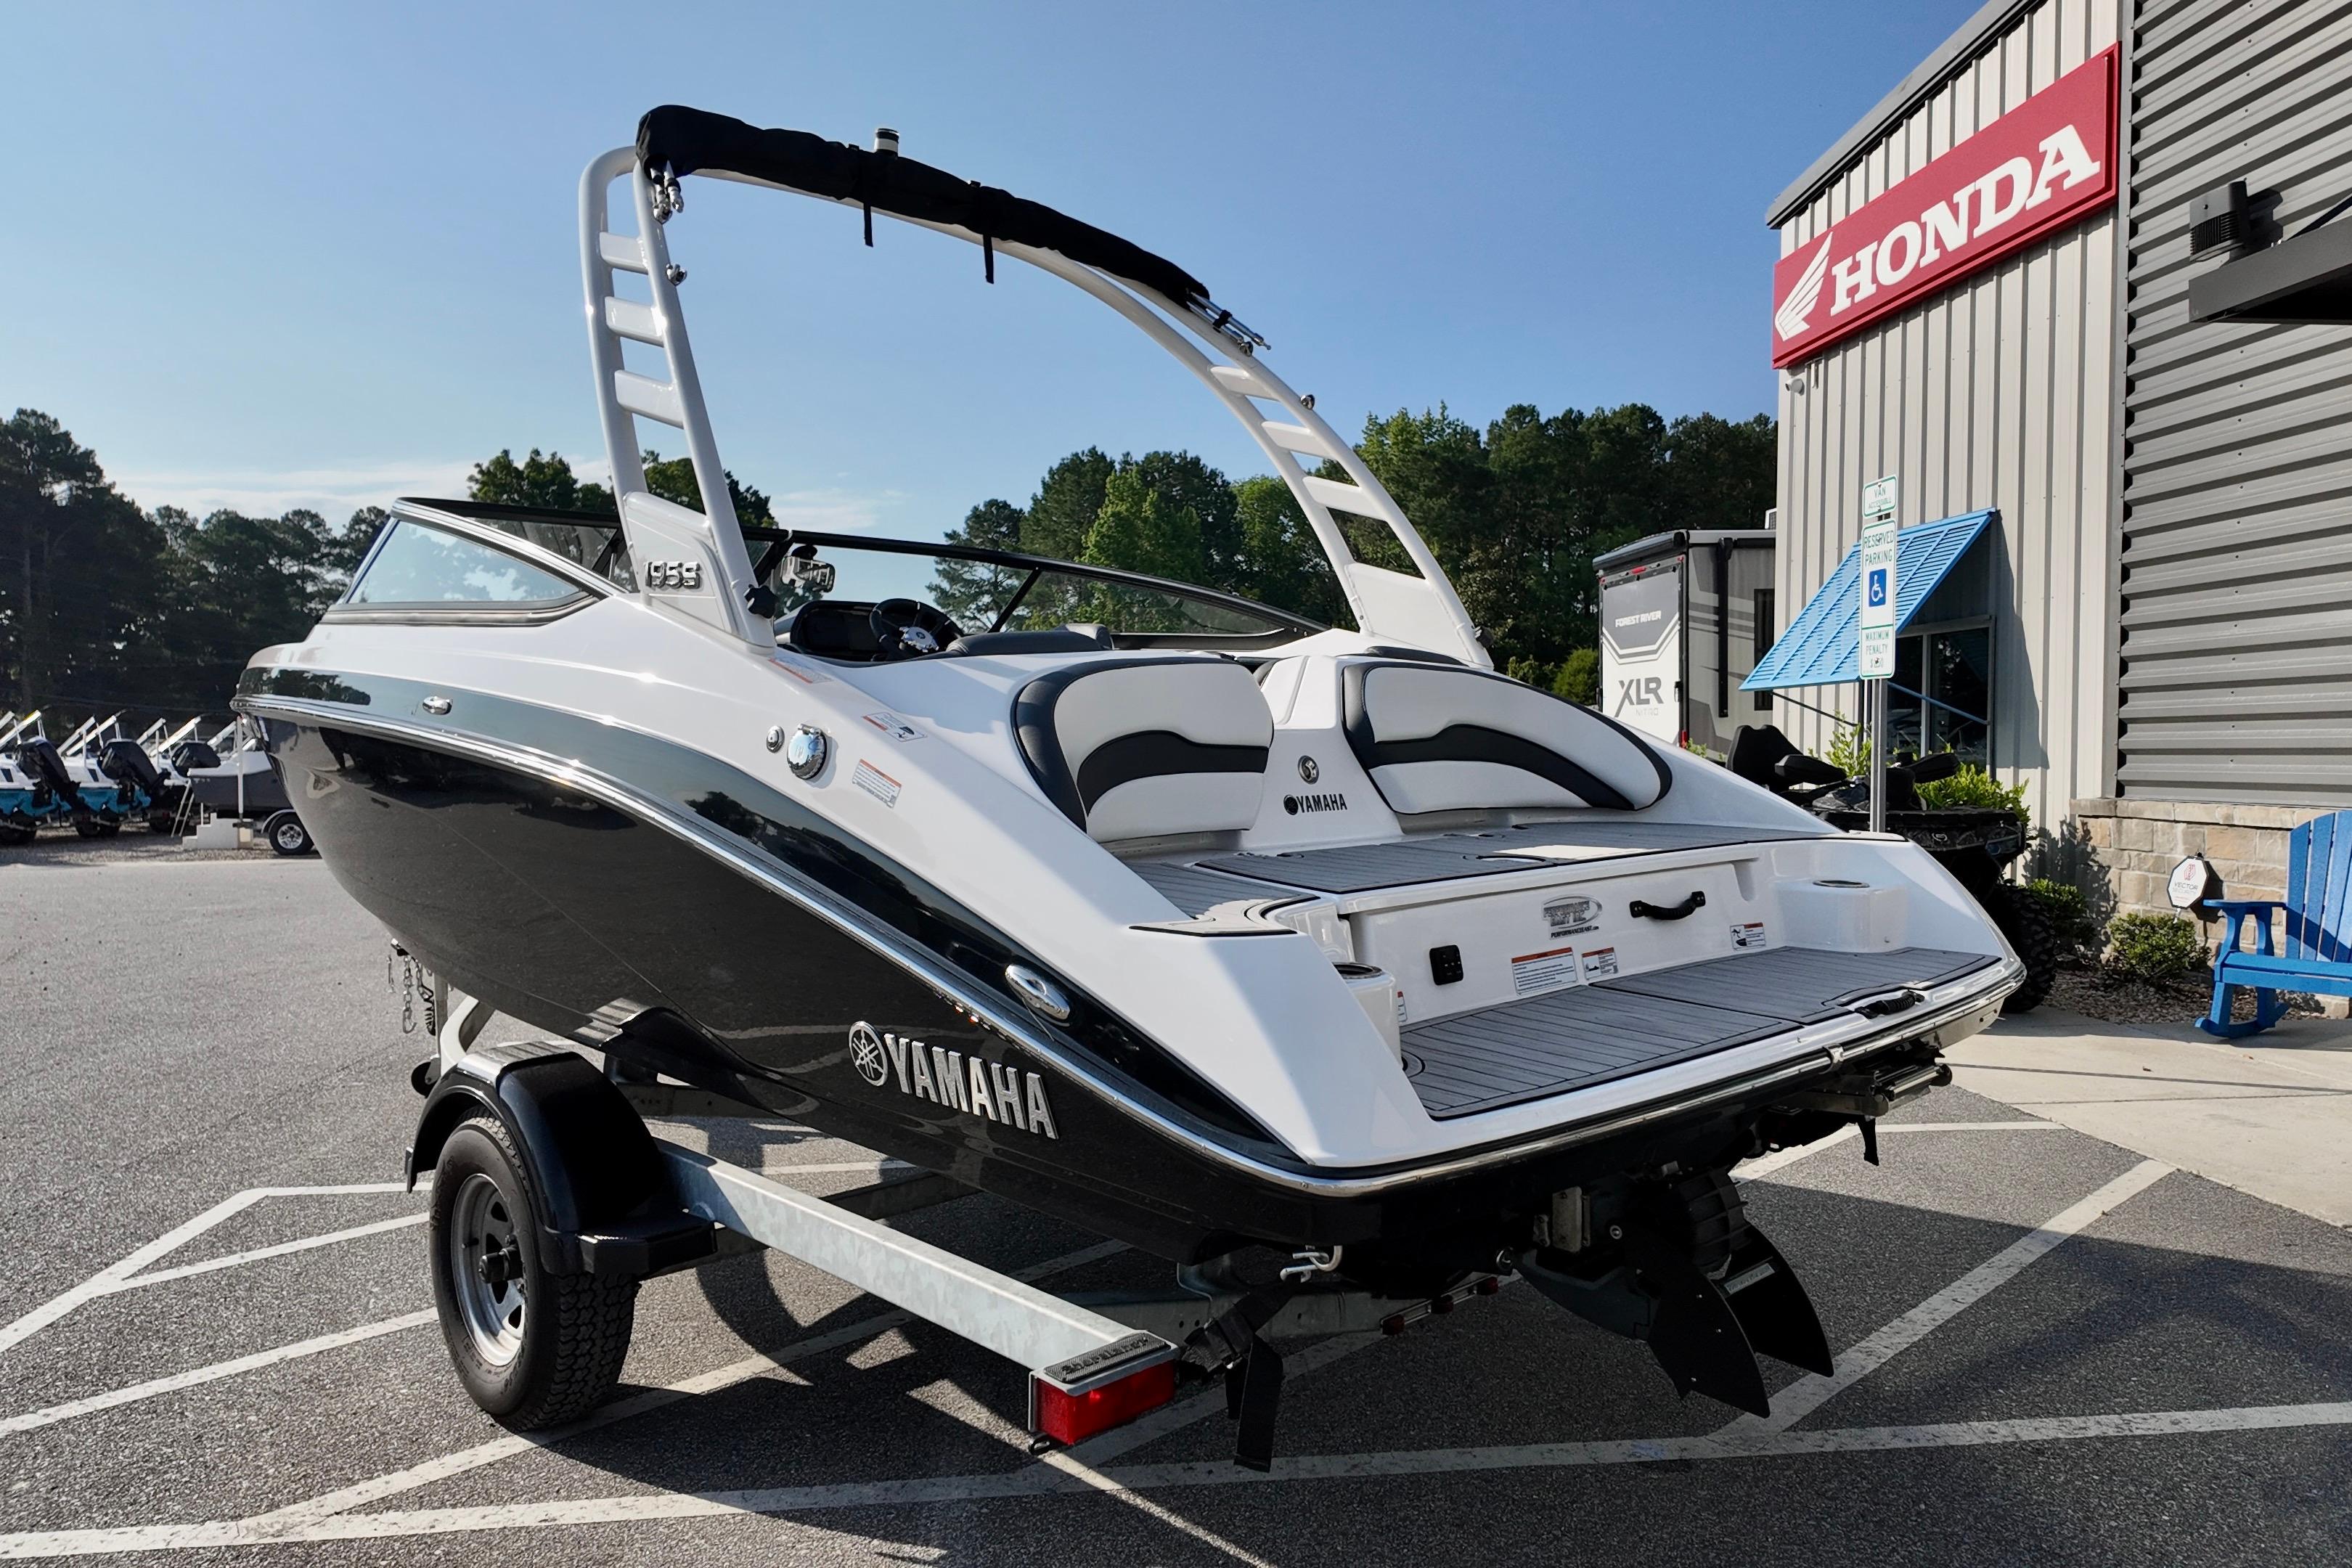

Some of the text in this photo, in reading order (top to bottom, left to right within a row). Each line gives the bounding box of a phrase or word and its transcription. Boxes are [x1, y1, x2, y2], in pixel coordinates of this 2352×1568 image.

[1830, 124, 2100, 317] HONDA
[1874, 486, 1886, 499] VAN
[1863, 530, 1894, 550] RESERVED
[1865, 548, 1892, 566] PARKING
[1615, 610, 1662, 628] FOREST RIVER
[1866, 630, 1890, 641] MAXIMUM
[1866, 643, 1888, 656] PENALTY
[1614, 677, 1665, 718] XLR
[1636, 708, 1659, 716] NITRO
[1296, 793, 1347, 813] YAMAHA
[2174, 881, 2198, 890] VECTOR
[884, 1033, 1059, 1140] YAMAHA
